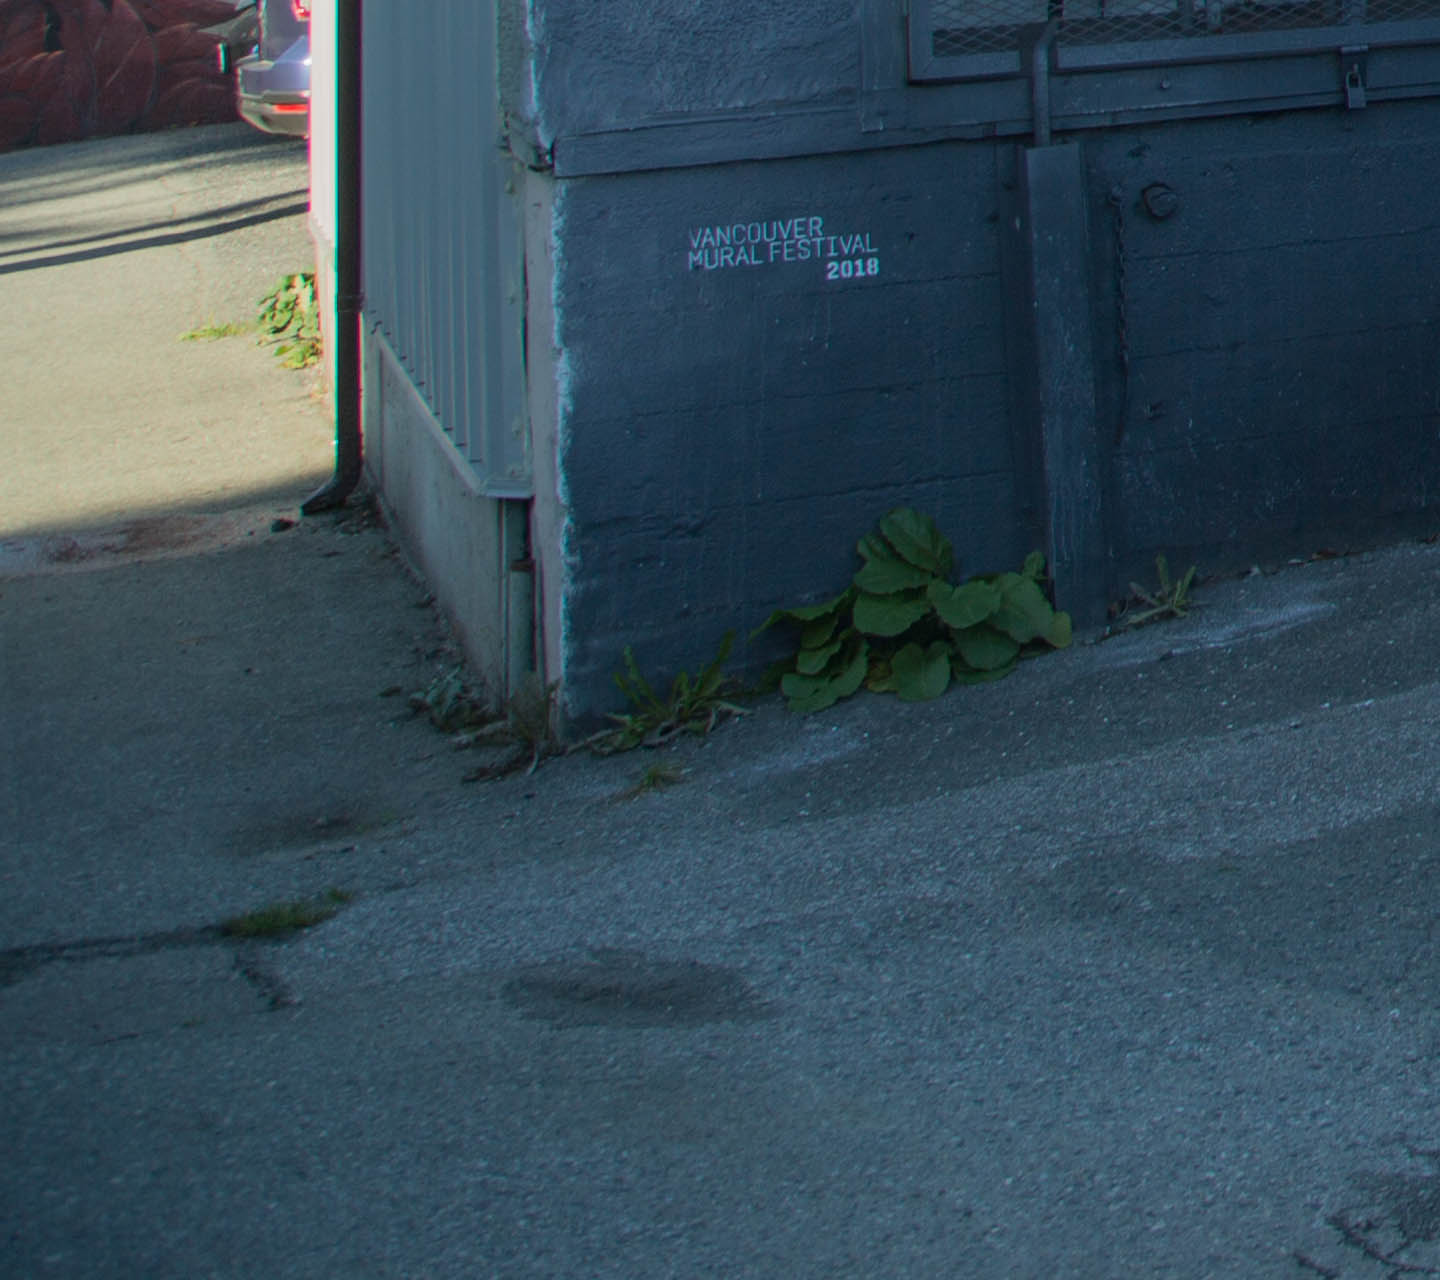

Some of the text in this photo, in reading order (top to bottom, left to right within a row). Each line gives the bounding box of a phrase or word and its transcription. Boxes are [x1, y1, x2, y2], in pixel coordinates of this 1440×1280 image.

[688, 216, 824, 249] VANCOUVER
[688, 232, 879, 271] MURAL FESTIVAL
[826, 256, 880, 280] 2018
